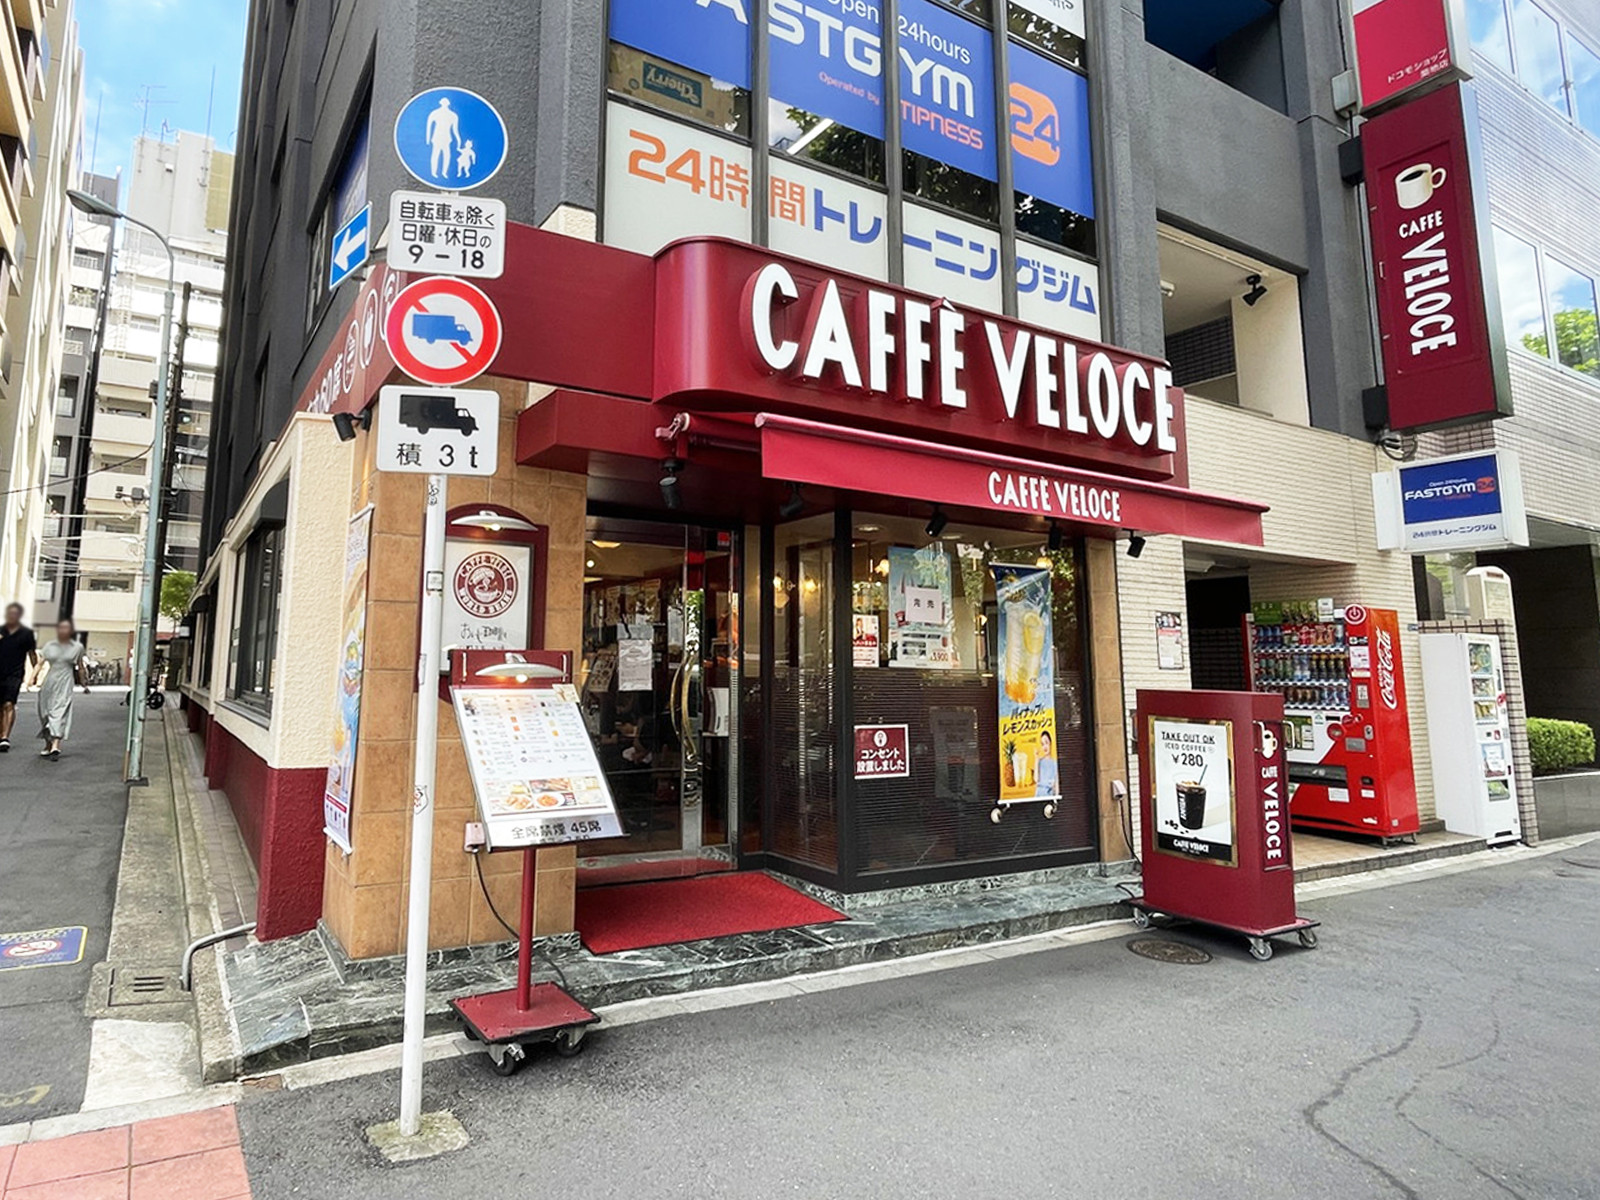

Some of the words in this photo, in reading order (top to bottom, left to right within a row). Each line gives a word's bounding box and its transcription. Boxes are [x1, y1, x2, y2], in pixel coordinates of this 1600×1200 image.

[898, 16, 972, 65] 24hours
[645, 65, 700, 104] Cherry
[818, 71, 865, 97] Operated
[866, 90, 880, 106] by
[900, 99, 984, 150] TIPNESS
[400, 200, 495, 227] 自転車を除く
[1399, 210, 1443, 238] CAFFE
[1401, 231, 1457, 356] VELOCE
[982, 319, 1177, 453] VELOCE
[396, 443, 422, 467] 積
[1053, 481, 1121, 522] VELOCE
[1404, 482, 1476, 501] FASTGYM
[861, 748, 900, 759] コンセント
[1161, 731, 1181, 741] TAKE
[1182, 733, 1200, 743] OUT
[1202, 735, 1215, 744] OK
[856, 760, 905, 773] 設置しました
[1263, 781, 1282, 859] VELOCE
